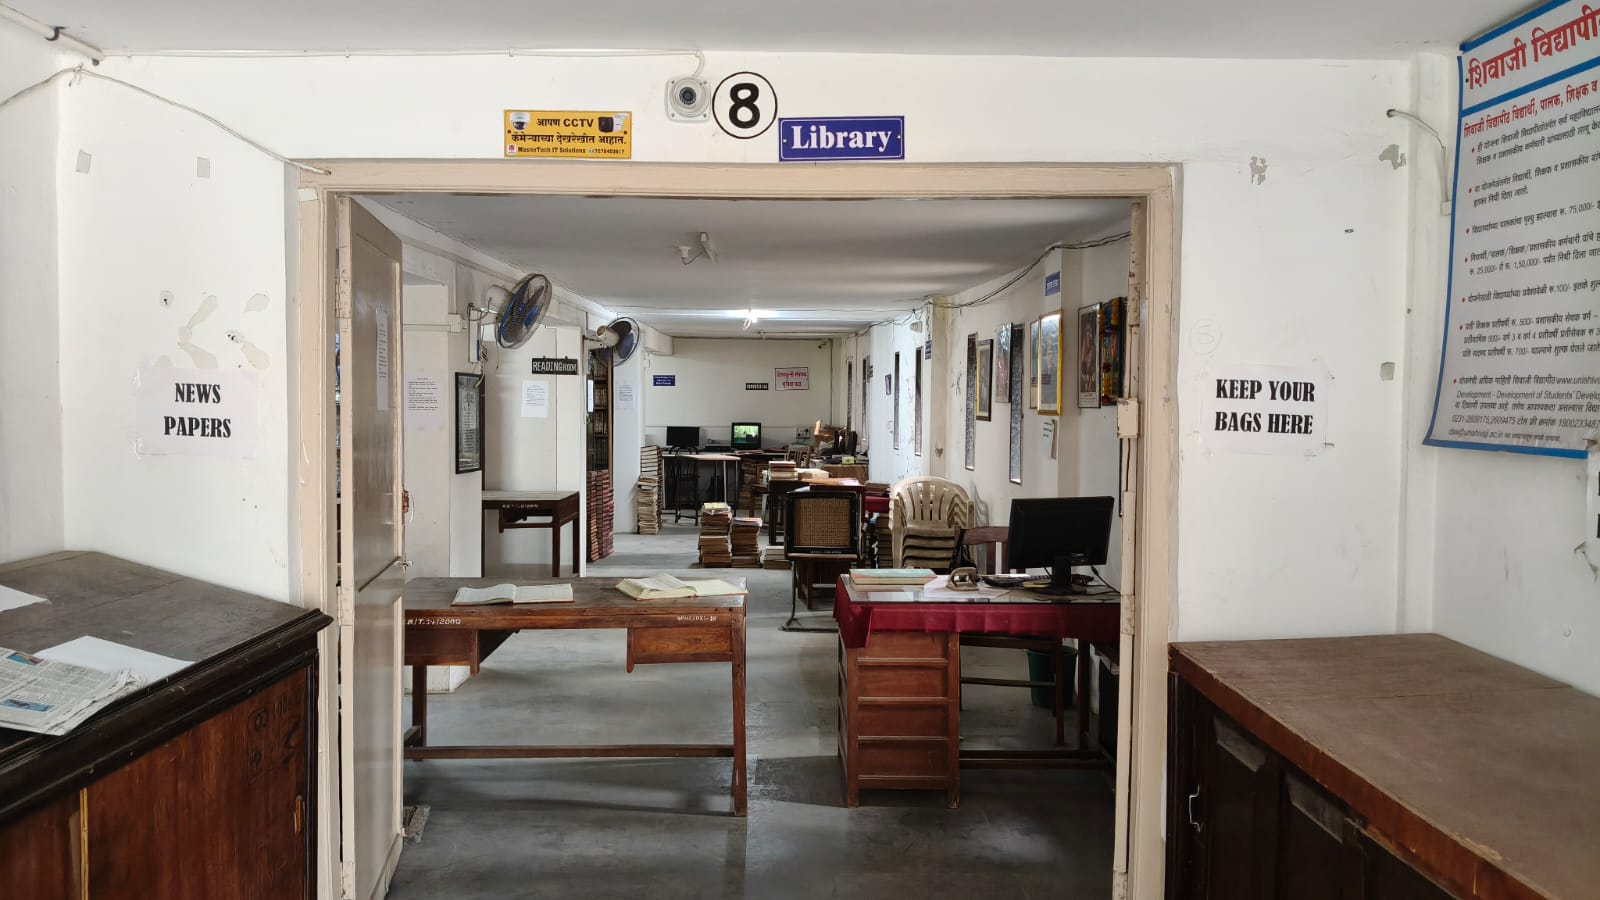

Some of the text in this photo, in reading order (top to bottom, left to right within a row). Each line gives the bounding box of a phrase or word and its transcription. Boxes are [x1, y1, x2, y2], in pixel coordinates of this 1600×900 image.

[1468, 5, 1600, 90] शिवाजी विद्यापी
[728, 82, 760, 128] 8
[1464, 117, 1484, 138] शिवाजी
[1486, 110, 1510, 131] विद्यापीठ
[1540, 94, 1563, 111] पालक,
[1566, 84, 1589, 102] शिक्षक
[1592, 80, 1598, 92] व
[536, 118, 594, 128] आपण CCTV
[791, 124, 892, 152] Library
[175, 383, 220, 404] NEWS
[1216, 379, 1315, 402] KEEP YOUR
[164, 416, 231, 438] PAPERS
[1214, 412, 1314, 434] BAGS HERE
